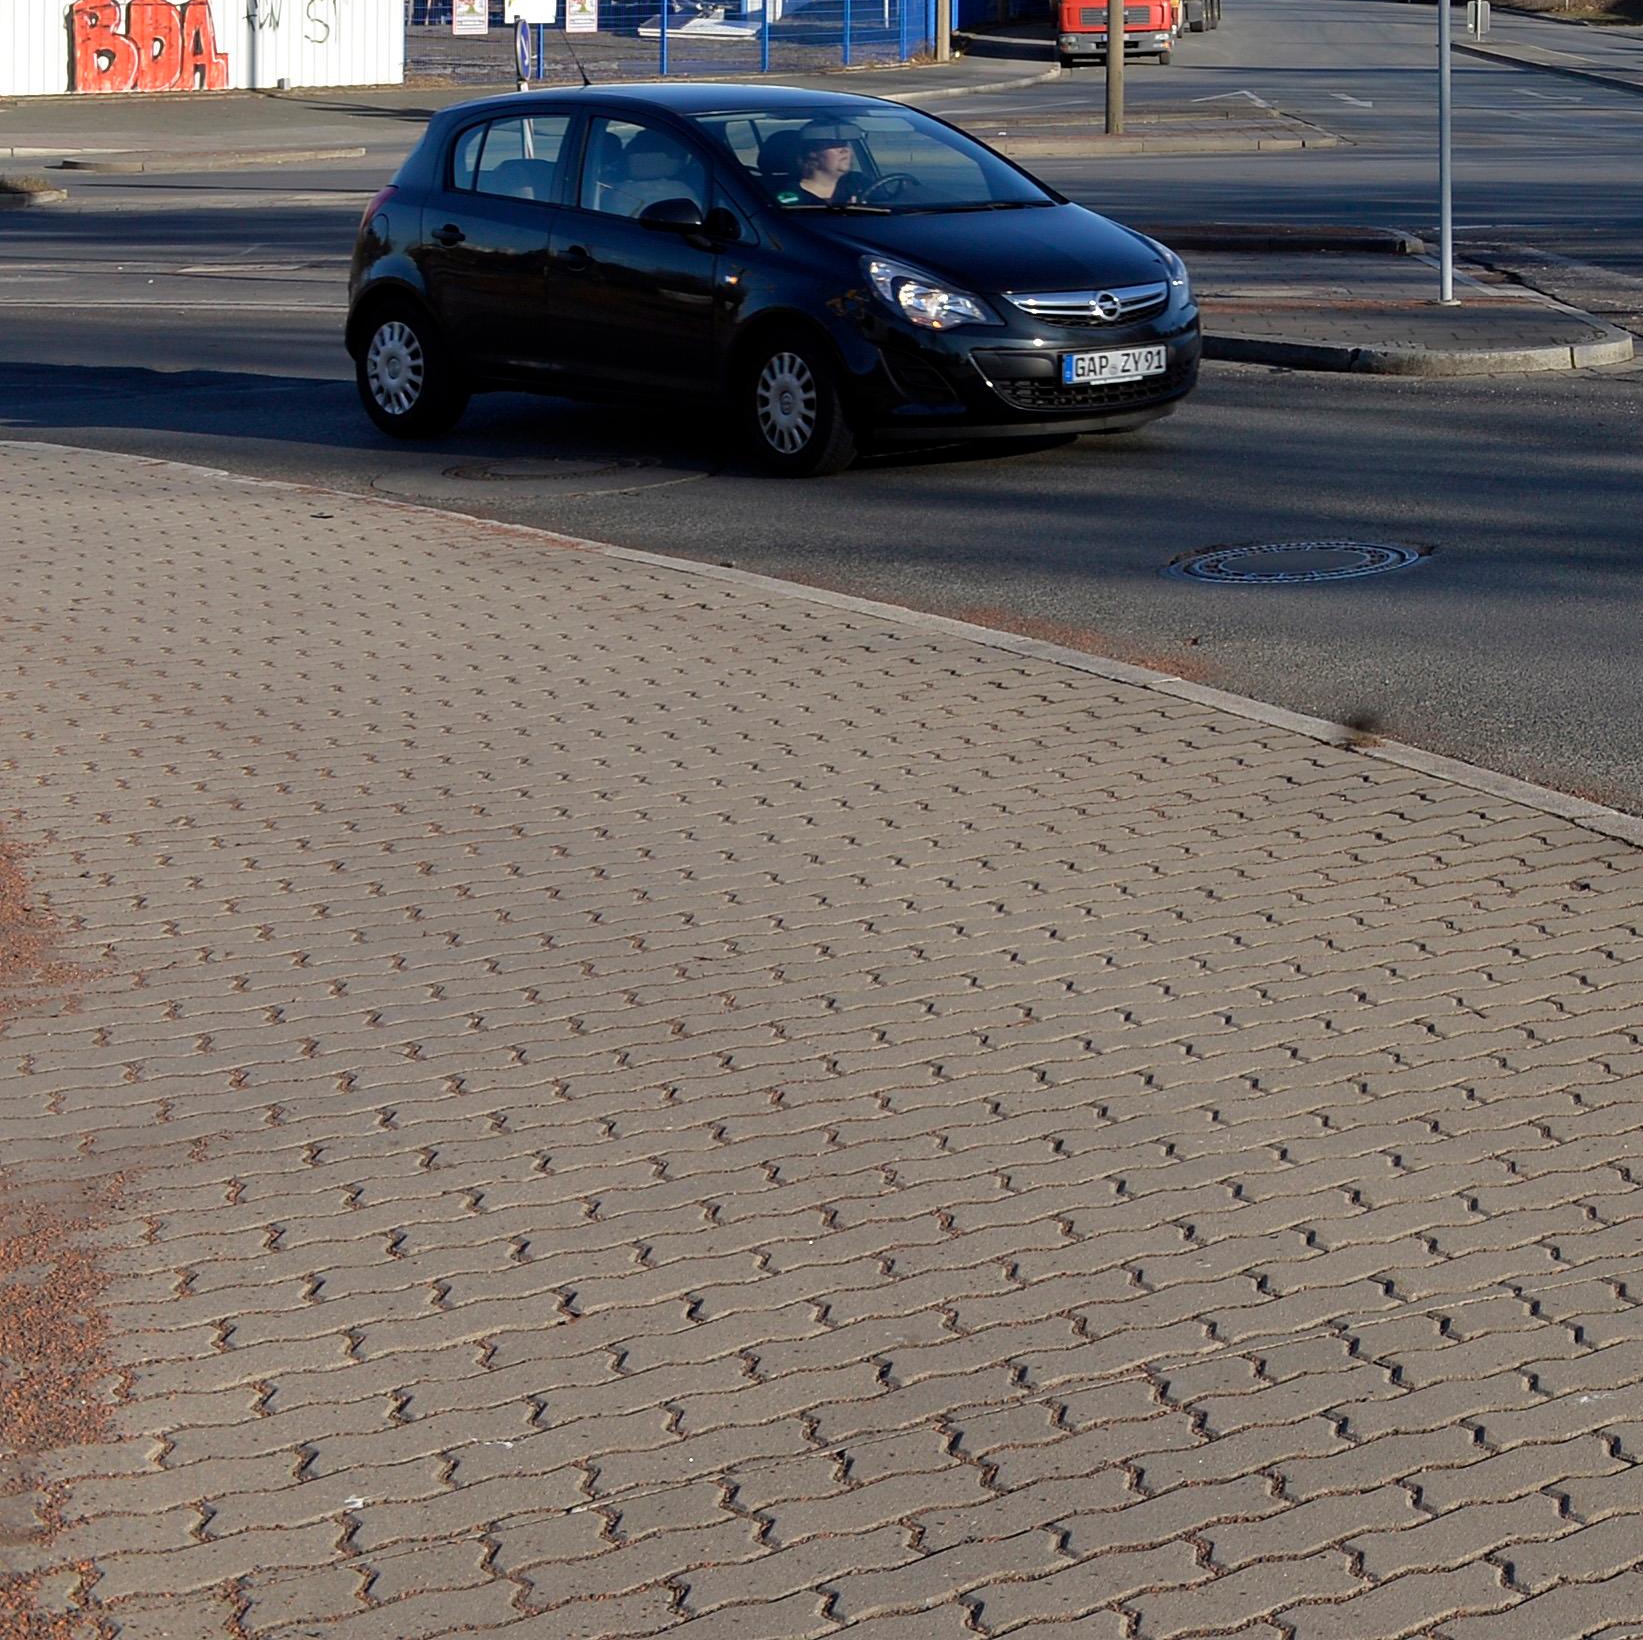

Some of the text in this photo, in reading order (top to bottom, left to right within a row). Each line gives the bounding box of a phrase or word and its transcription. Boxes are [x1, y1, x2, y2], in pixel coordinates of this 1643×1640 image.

[1075, 349, 1164, 378] GAP ZY 91
